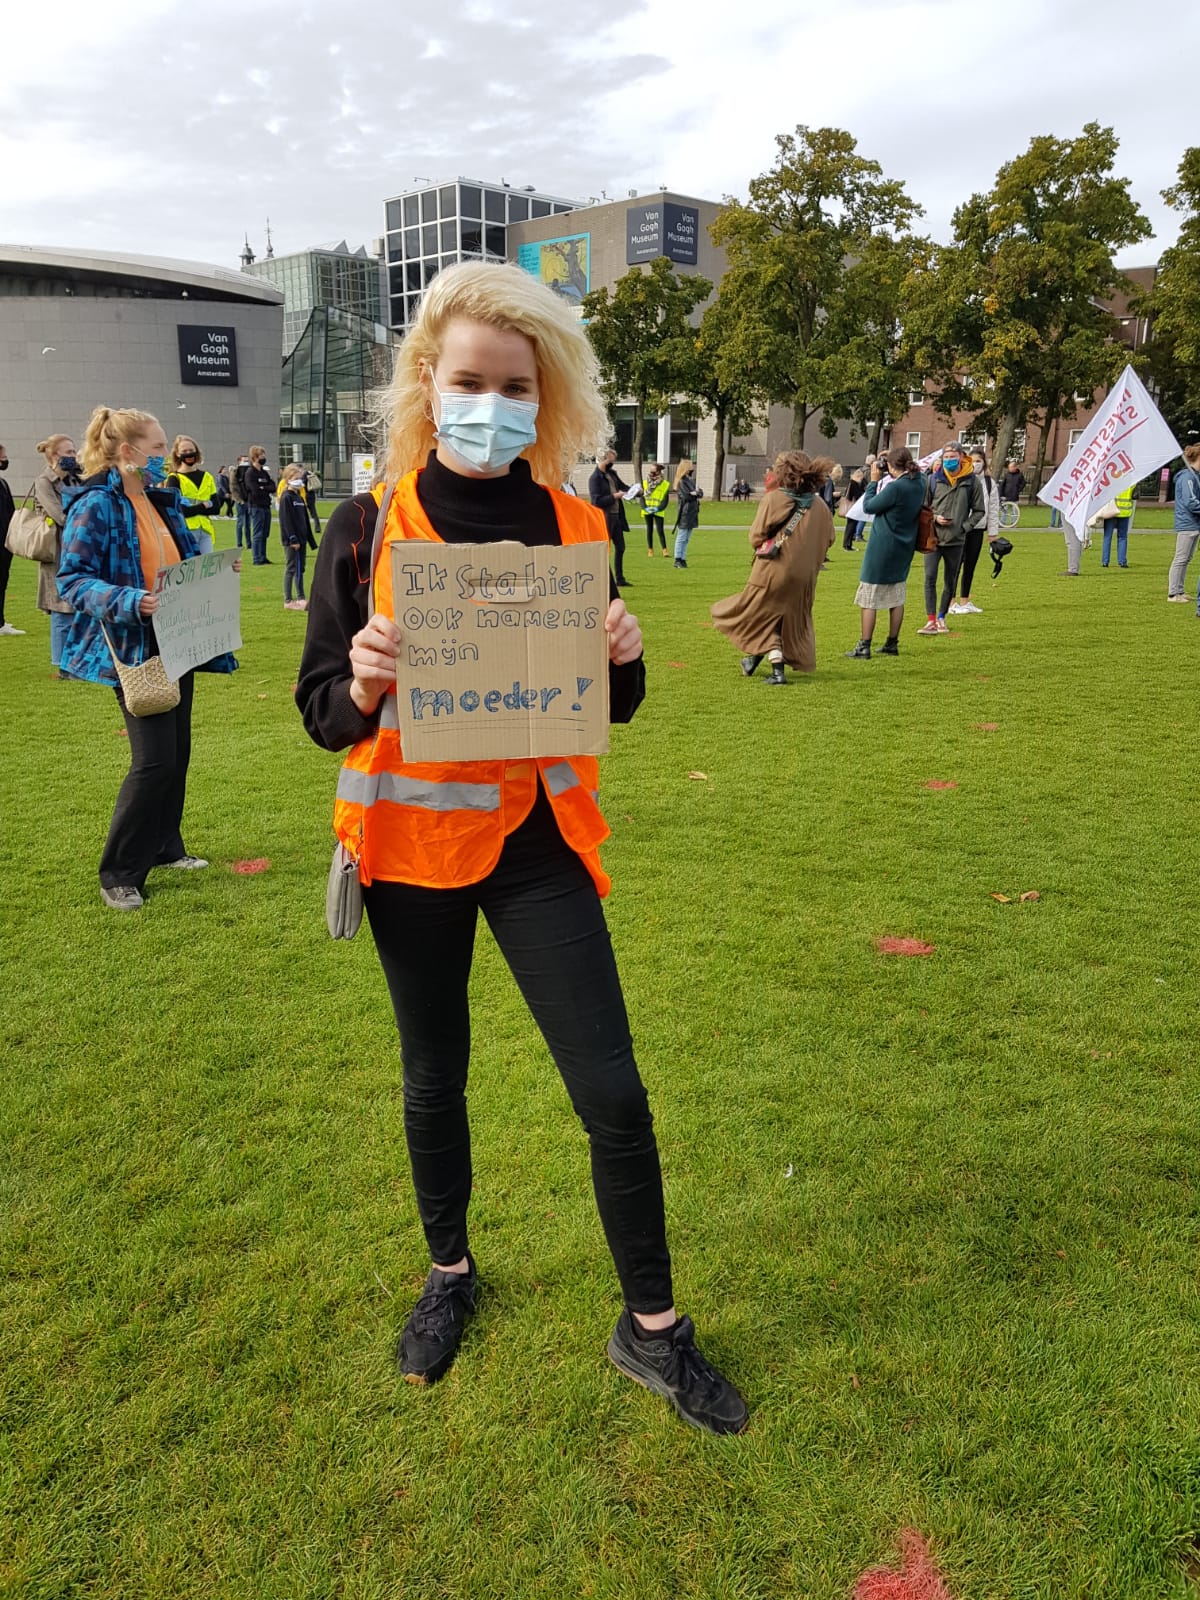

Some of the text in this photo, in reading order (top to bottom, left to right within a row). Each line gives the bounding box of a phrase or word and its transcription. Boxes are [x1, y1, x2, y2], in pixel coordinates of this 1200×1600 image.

[645, 211, 659, 221] Van
[681, 211, 694, 223] Van
[640, 221, 659, 233] Gogh
[676, 222, 694, 234] Gogh
[631, 233, 659, 245] Museum
[667, 231, 694, 245] Museum
[207, 332, 228, 343] Van
[200, 343, 229, 356] Gogh
[187, 354, 230, 365] Museum
[402, 563, 448, 596] Ik
[477, 606, 600, 629] namens
